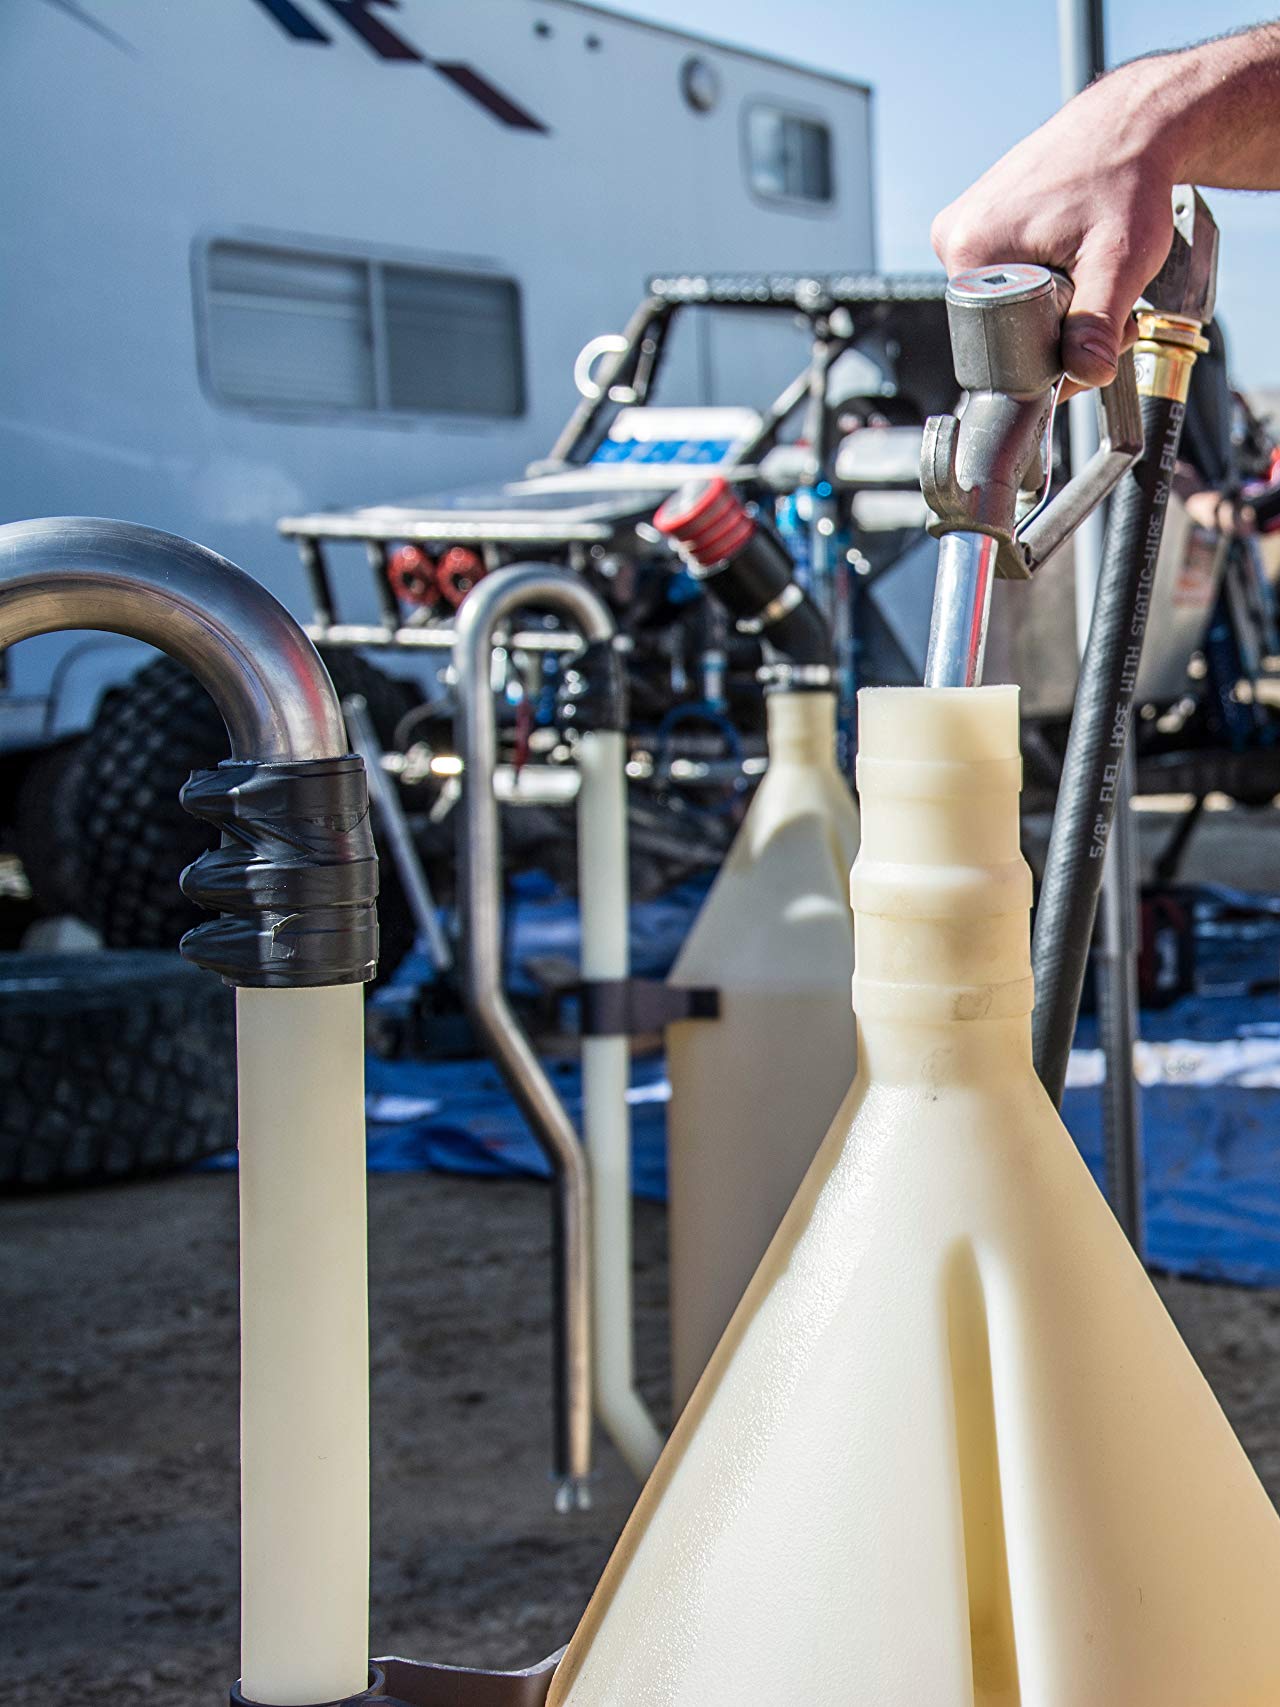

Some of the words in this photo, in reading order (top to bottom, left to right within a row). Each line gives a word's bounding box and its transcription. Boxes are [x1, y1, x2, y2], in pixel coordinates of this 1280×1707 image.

[1153, 481, 1169, 505] BY
[1131, 513, 1163, 637] STATIC-WIRE
[1120, 646, 1141, 693] WITH
[1110, 702, 1132, 748] HOSE
[1100, 757, 1120, 803] FUEL
[1089, 813, 1110, 858] 5/8"
